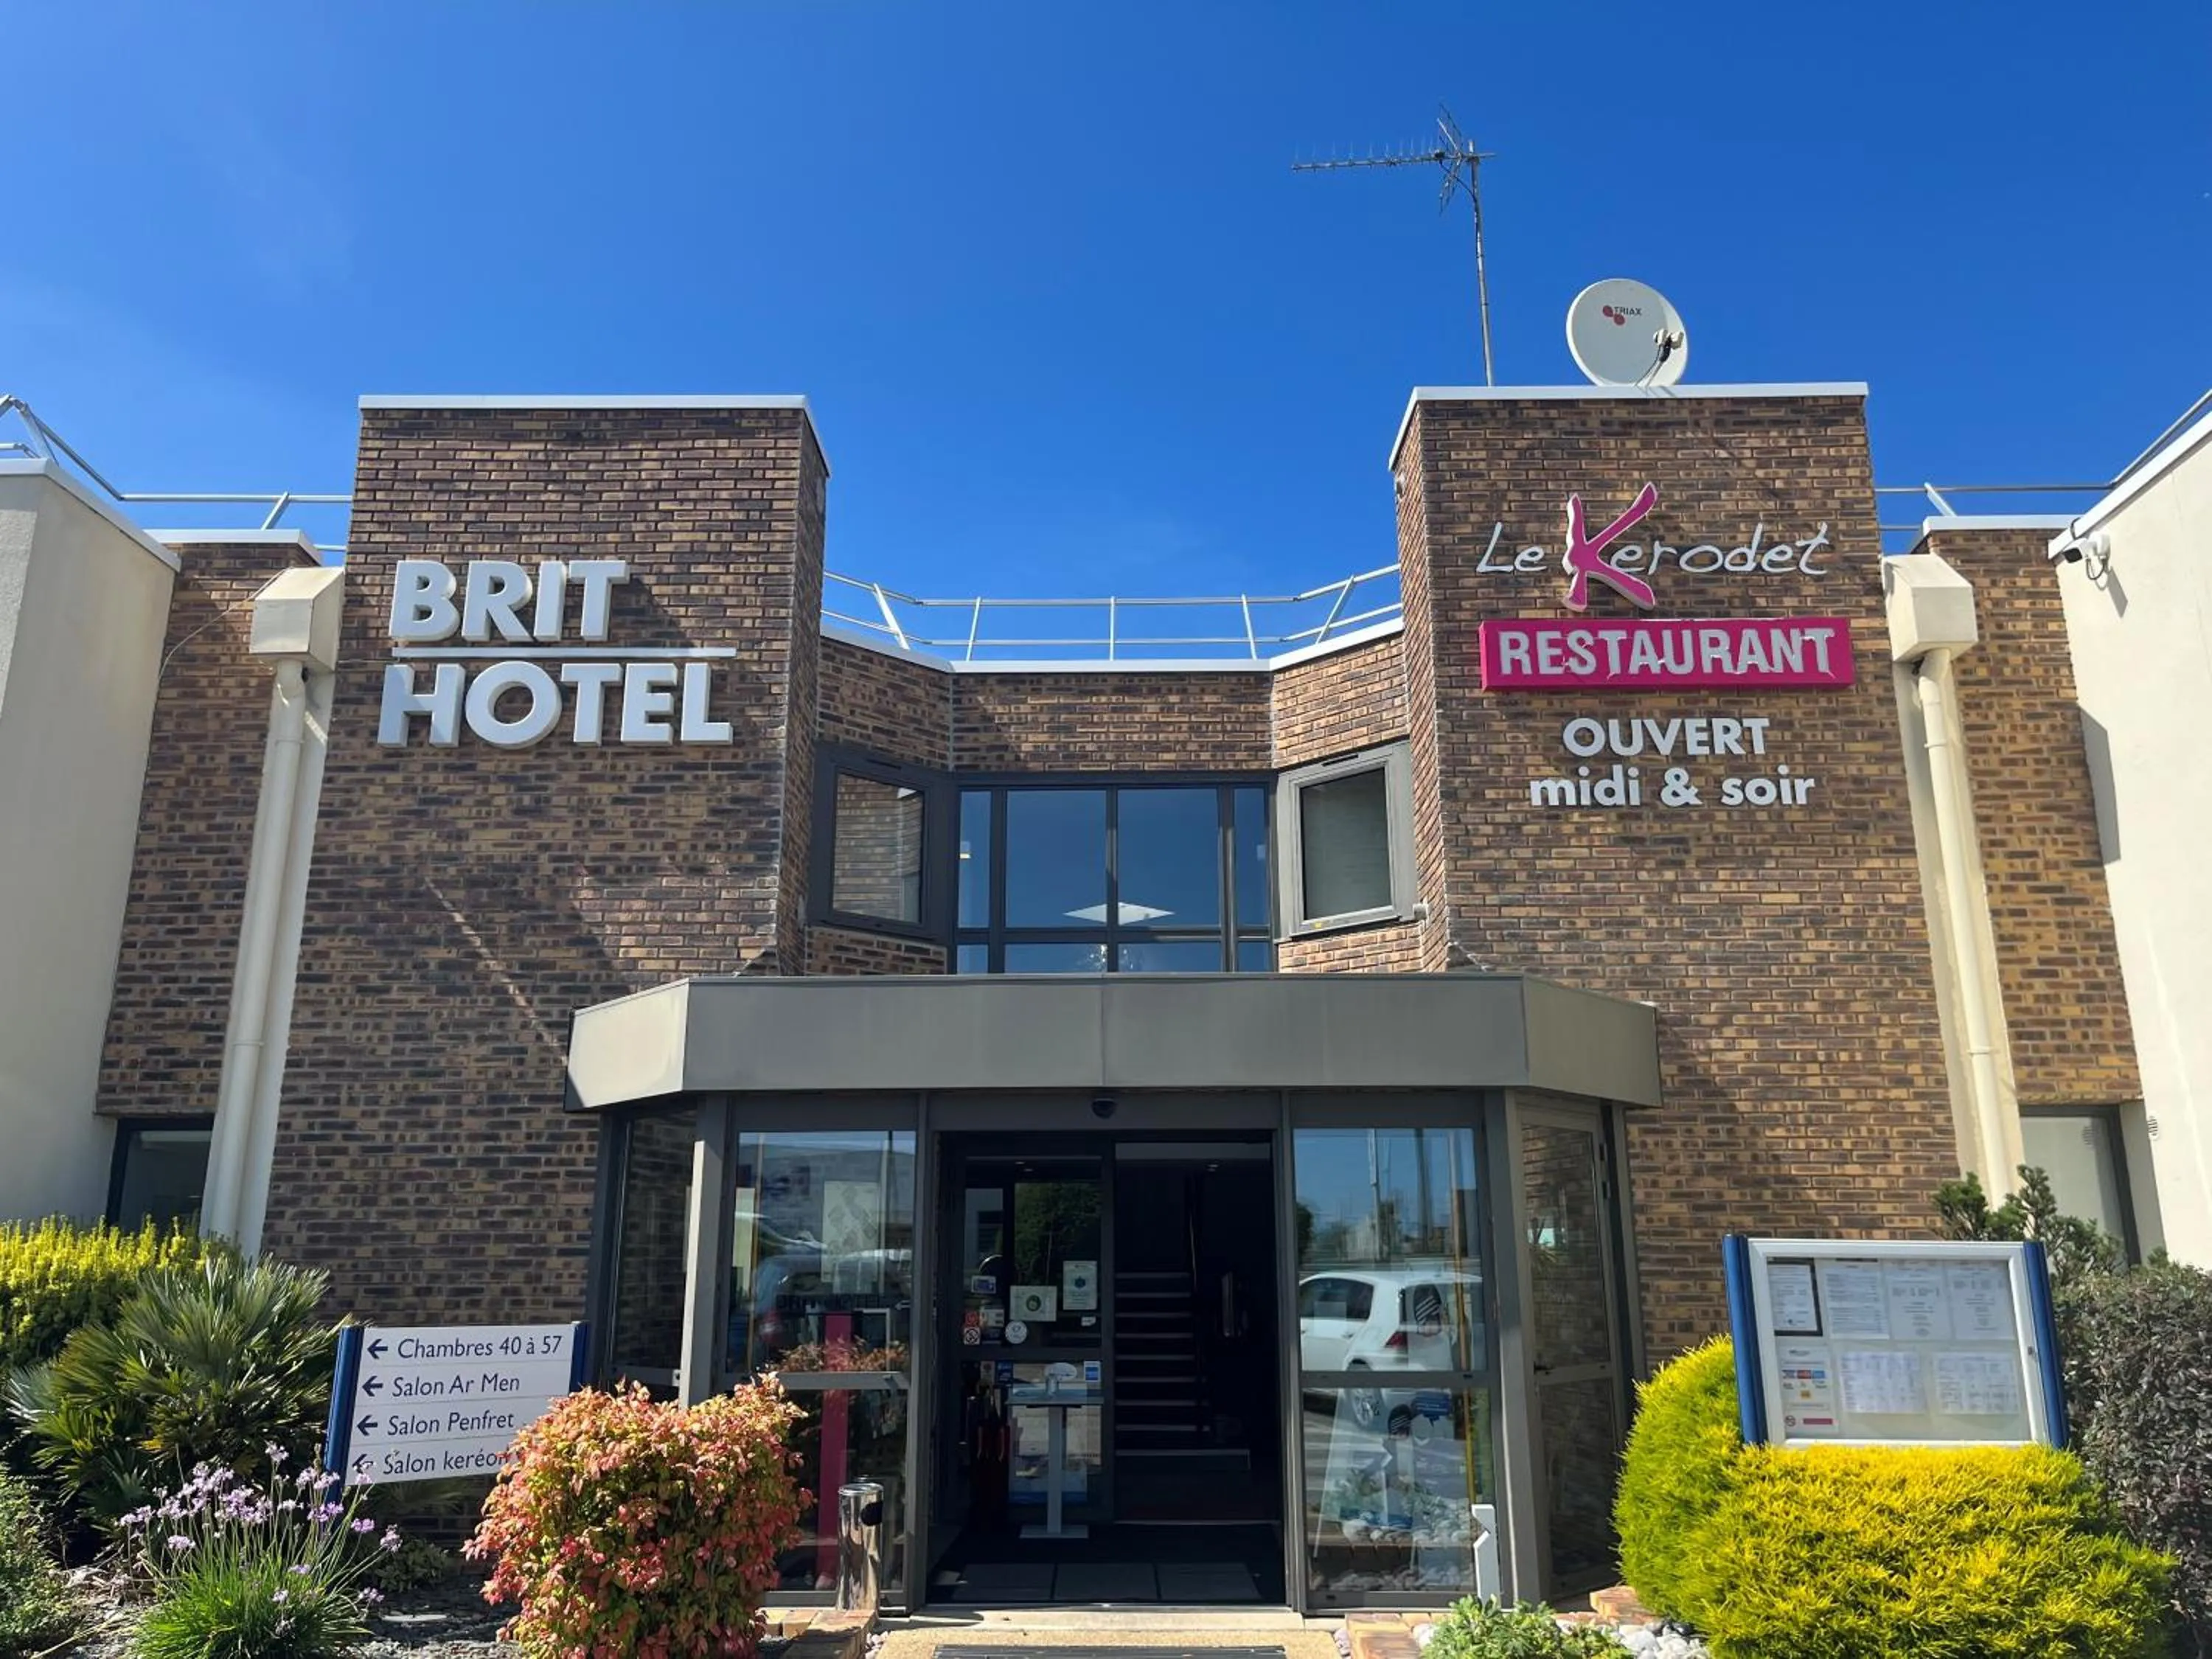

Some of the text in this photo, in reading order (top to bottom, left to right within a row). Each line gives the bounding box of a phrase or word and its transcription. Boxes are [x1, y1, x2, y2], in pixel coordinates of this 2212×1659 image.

[1613, 306, 1643, 316] TRIAX
[1475, 481, 1830, 612] Le Kerodet
[389, 560, 630, 643] BRIT
[1498, 627, 1834, 676] RESTAURANT
[377, 661, 734, 750] HOTEL
[1562, 717, 1770, 757] OUVERT
[1529, 764, 1815, 807] midi & soir
[397, 1335, 563, 1359] Chambres 40 à 57
[392, 1373, 520, 1397] Salon Ar Men
[387, 1410, 514, 1436] Salon Penfret
[383, 1451, 436, 1475] Salon
